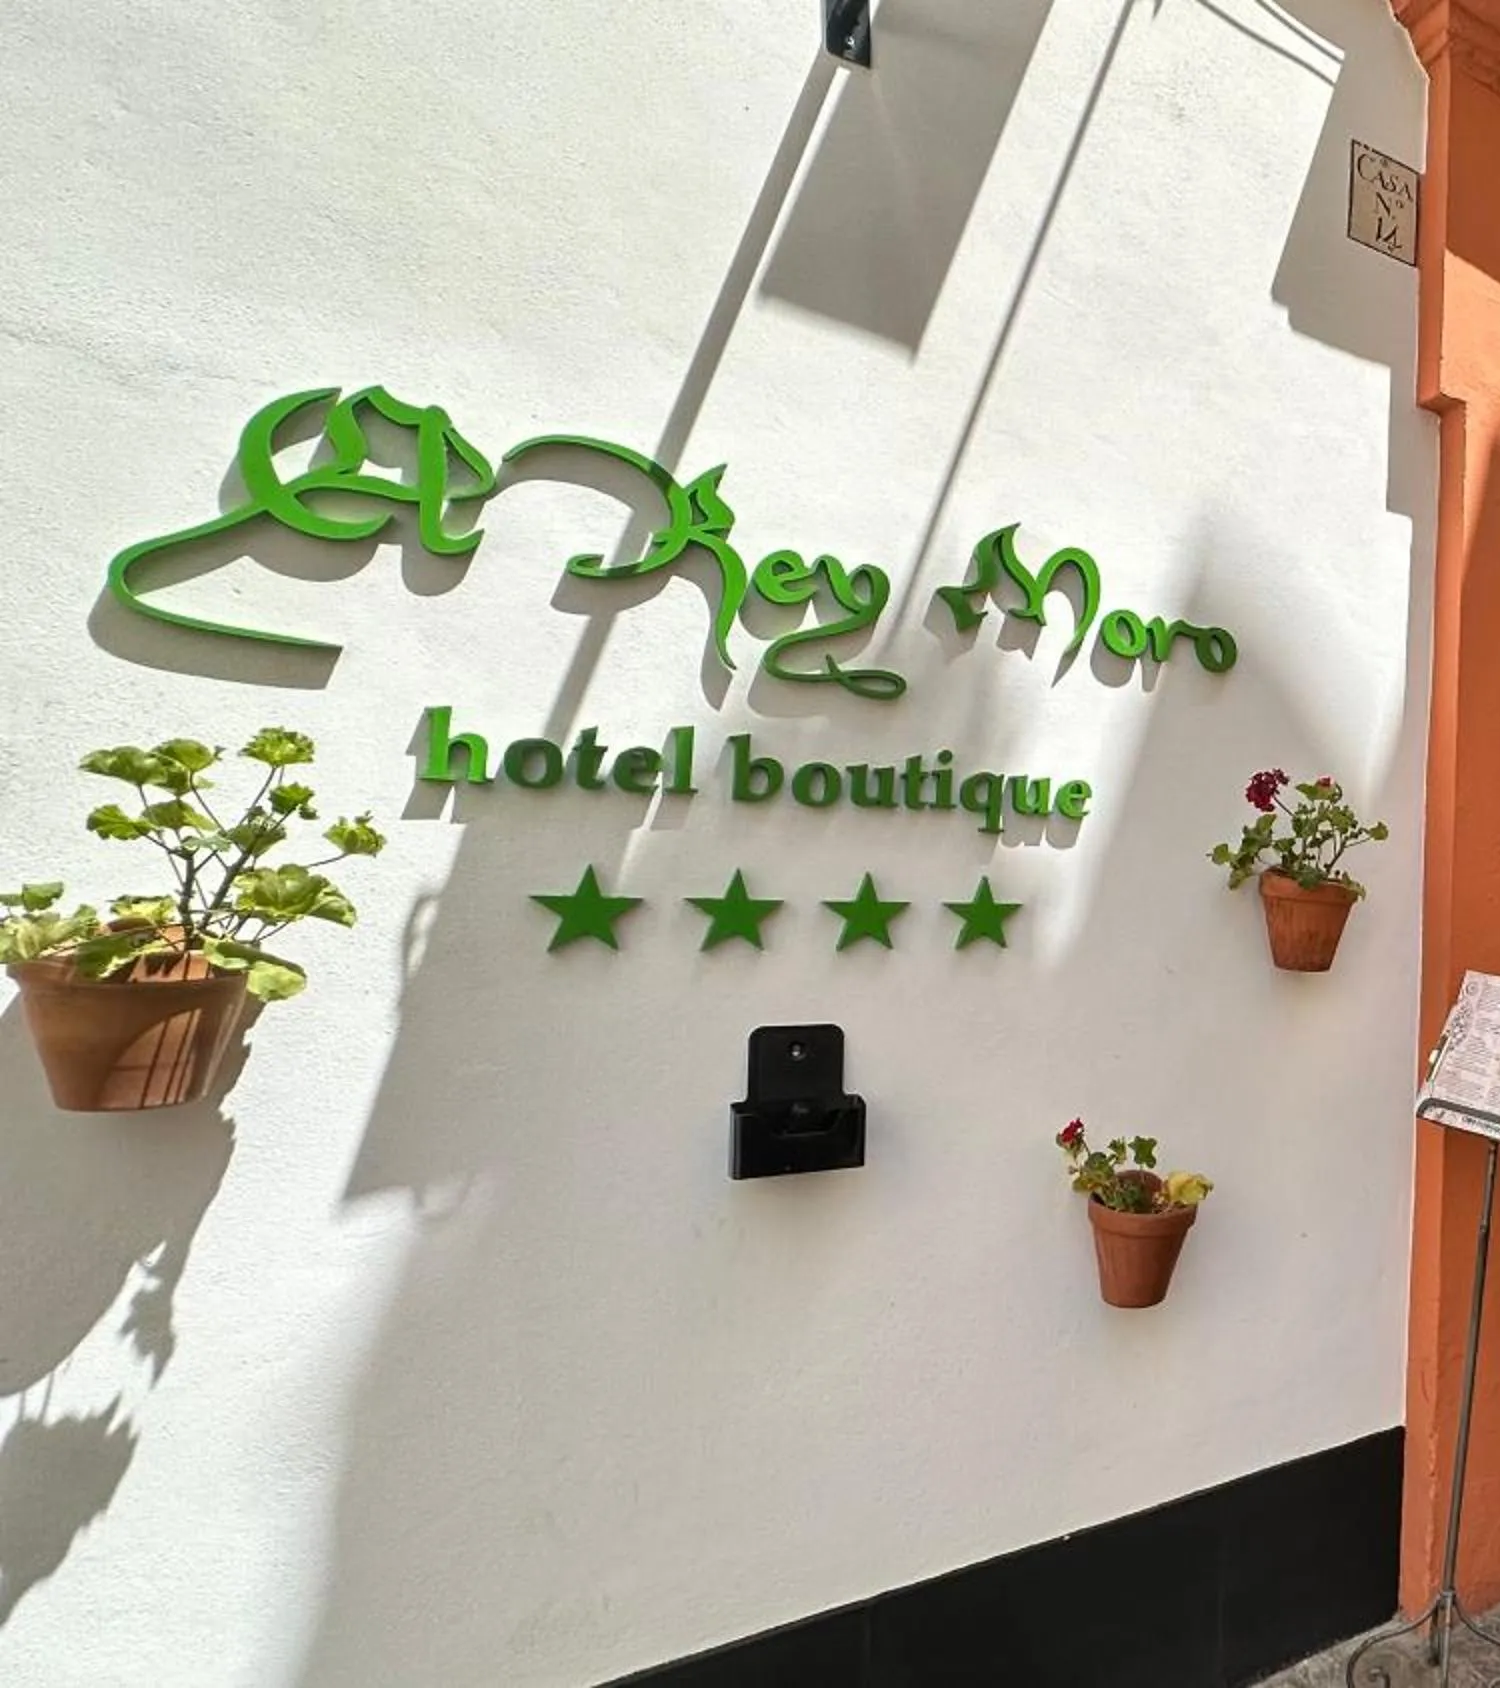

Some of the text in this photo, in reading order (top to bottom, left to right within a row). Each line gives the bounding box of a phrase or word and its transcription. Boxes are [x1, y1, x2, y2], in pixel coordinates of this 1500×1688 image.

[502, 435, 907, 700] Rey
[935, 522, 1238, 673] Moro
[416, 705, 1092, 834] hotel boutique
